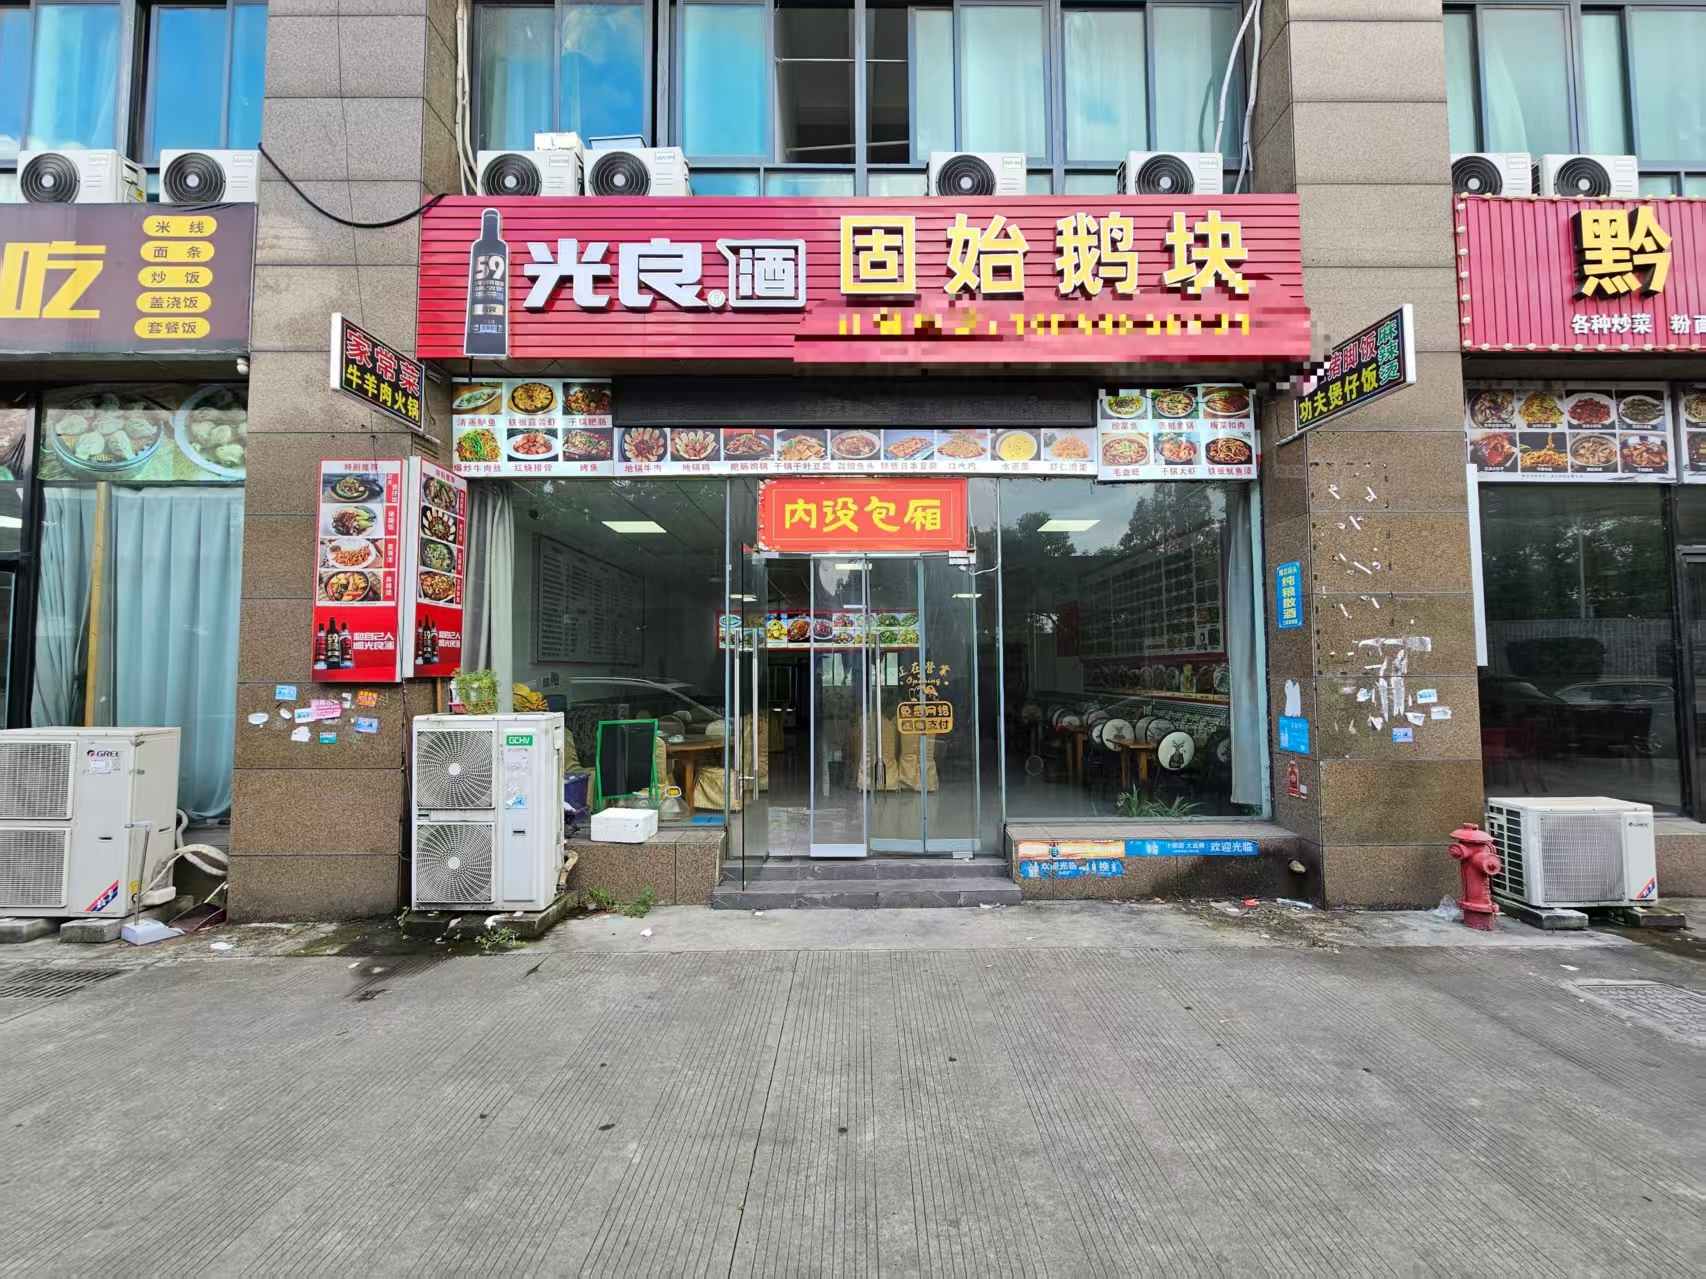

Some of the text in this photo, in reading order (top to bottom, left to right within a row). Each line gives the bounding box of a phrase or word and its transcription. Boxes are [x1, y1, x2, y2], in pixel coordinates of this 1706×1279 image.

[155, 220, 204, 234] 米线
[153, 246, 202, 259] 面条
[840, 210, 1249, 296] 固始鹅块
[1577, 206, 1673, 298] 黔
[474, 255, 505, 280] 59
[150, 271, 200, 285] 炒饭
[149, 296, 198, 310] 盖浇饭
[147, 321, 197, 335] 套餐饭
[1571, 313, 1653, 335] 各种炒菜
[1377, 319, 1400, 386] 麻辣烫
[346, 329, 420, 397] 家常菜
[346, 364, 419, 421] 牛羊肉火锅
[1299, 363, 1379, 422] 功夫煲仔饭
[513, 463, 553, 473] 红烧排骨
[579, 463, 599, 473] 烤鱼
[624, 464, 663, 474] 地锅牛肉
[681, 463, 711, 473] 地锅鸡
[1112, 468, 1141, 477] 毛血旺
[1160, 467, 1197, 476] 干锅大虾
[784, 496, 942, 533] 内设包厢
[1210, 841, 1253, 853] 欢迎光临
